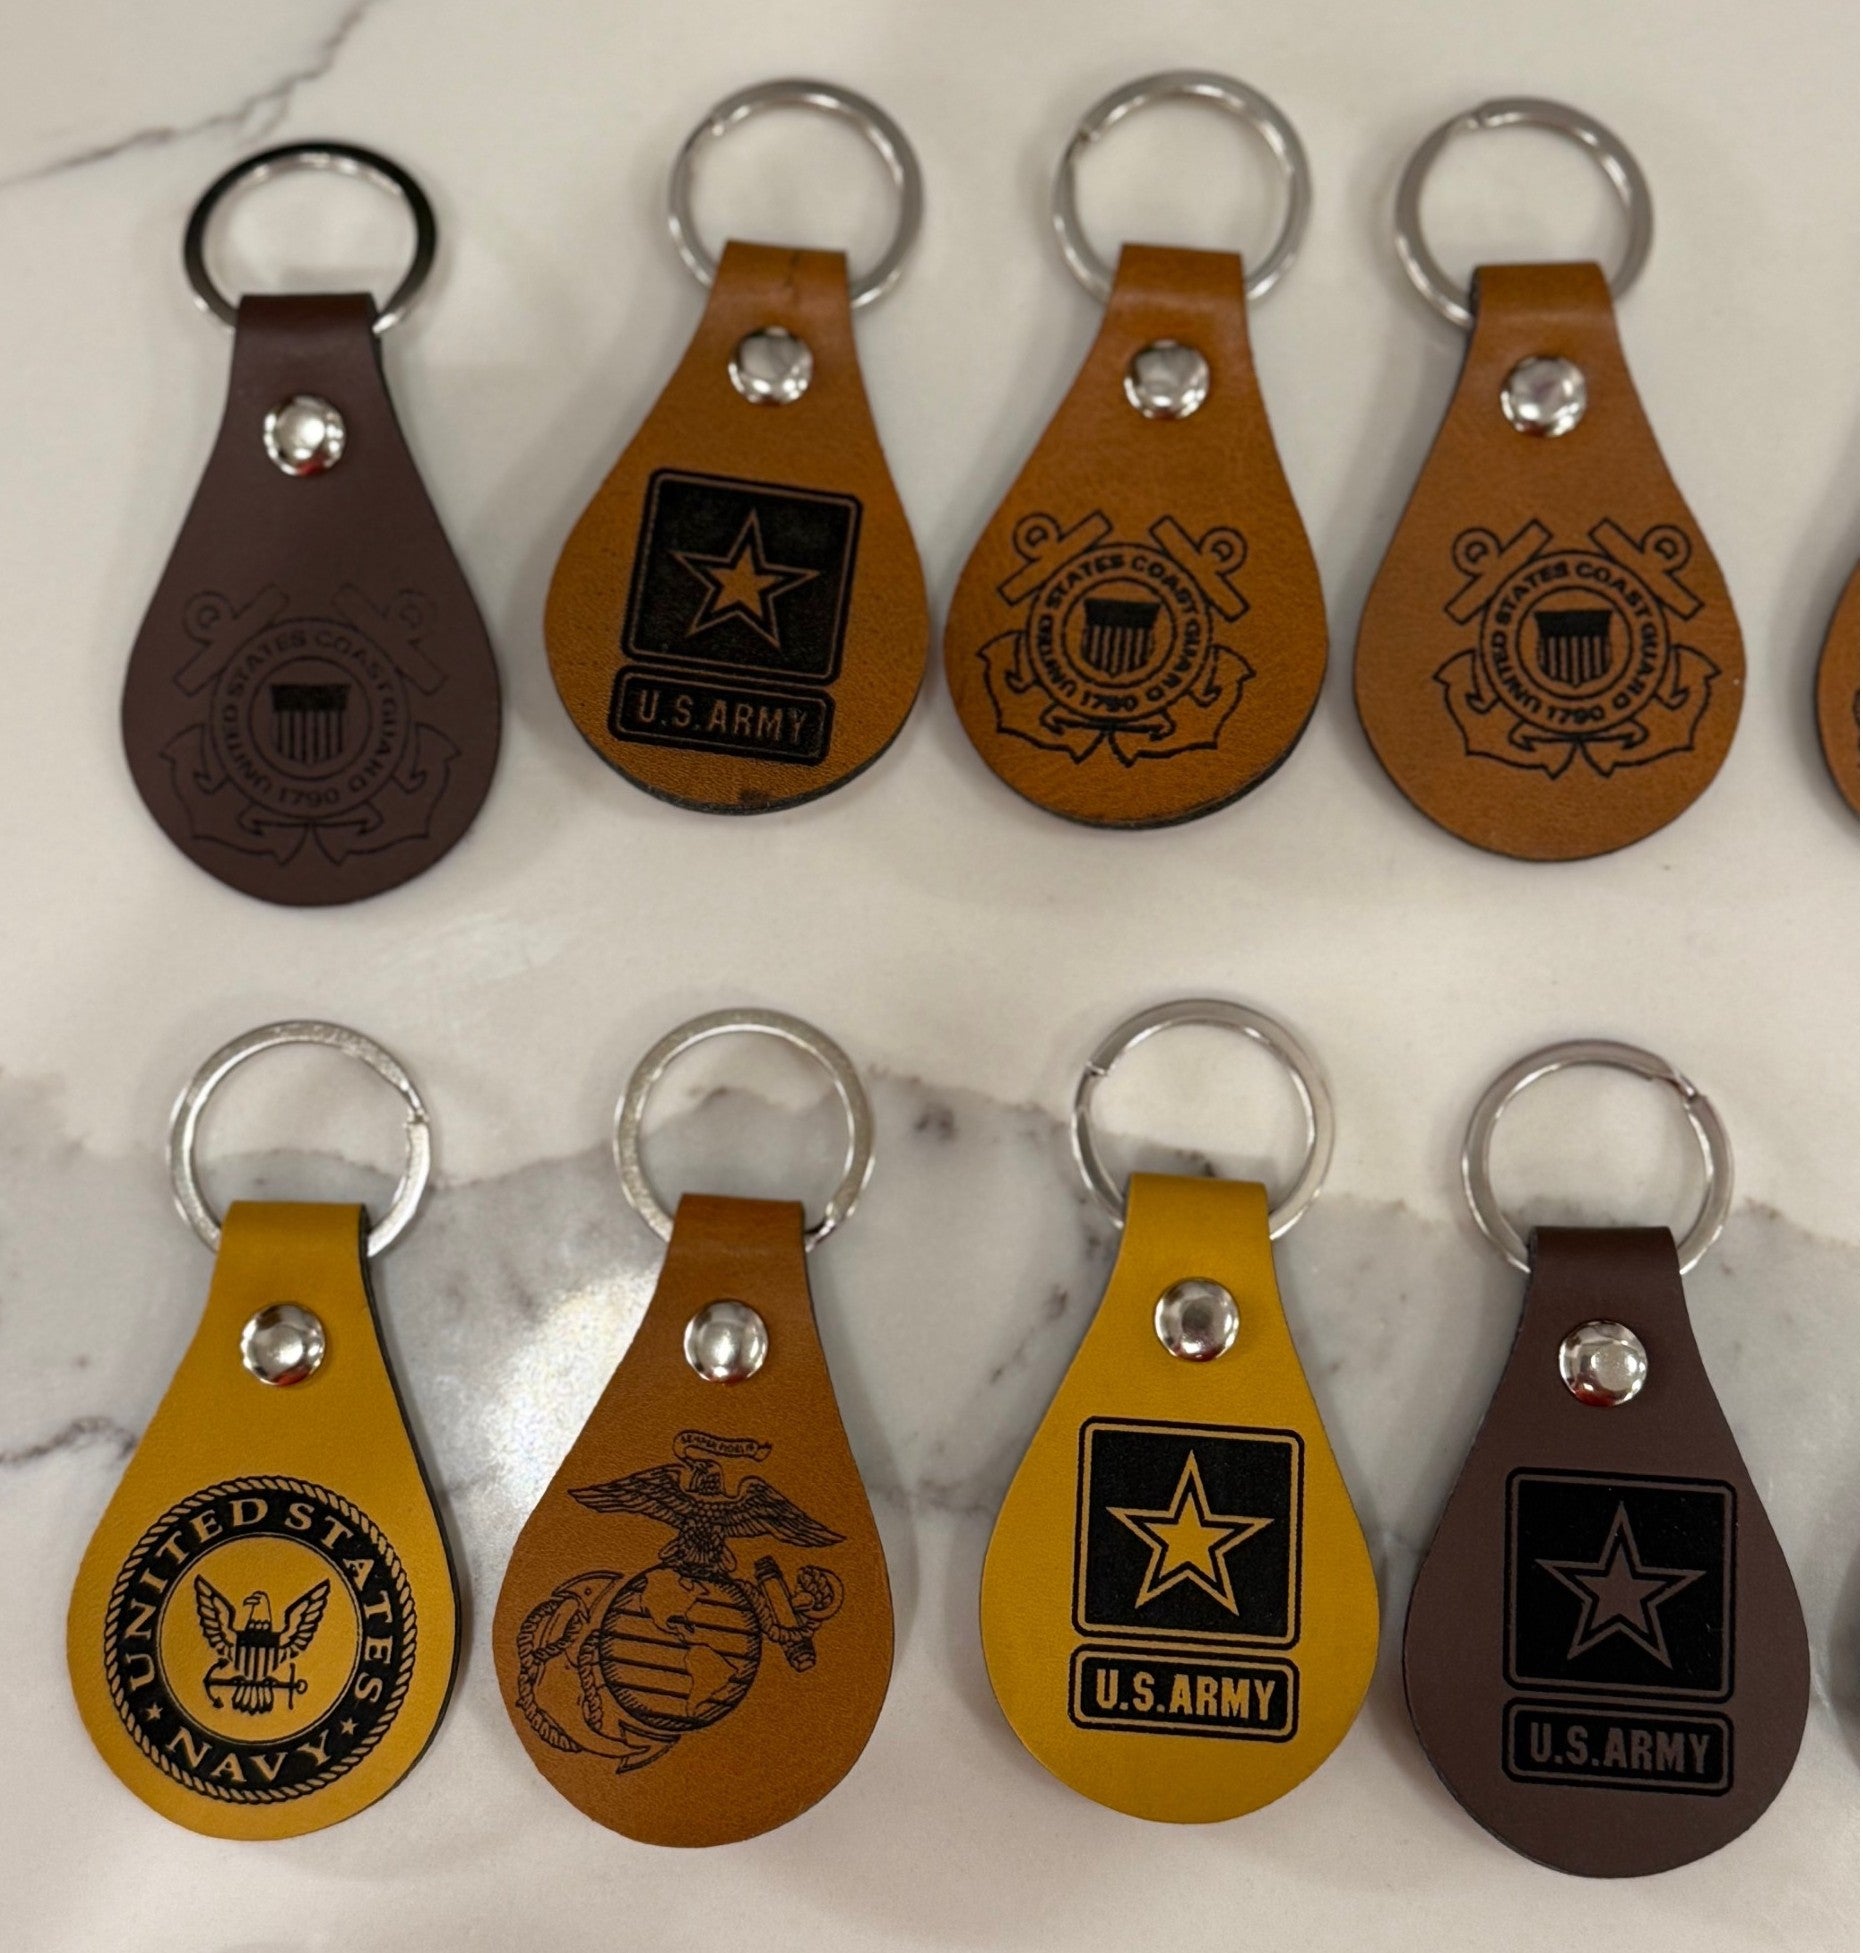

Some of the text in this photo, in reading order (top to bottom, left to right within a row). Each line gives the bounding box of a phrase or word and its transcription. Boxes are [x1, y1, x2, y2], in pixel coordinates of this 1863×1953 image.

[1038, 555, 1200, 700] UNITED STATES COAST GUARD
[1492, 561, 1657, 712] UNITED STATES COAST GUARD
[223, 631, 396, 793] UNITED STATES COAST GUARD
[1081, 690, 1138, 711] 1790
[1548, 706, 1605, 724] 1790
[280, 788, 339, 807] 1790
[125, 1498, 394, 1704] UNITED STATES
[166, 1726, 331, 1783] NAVY
